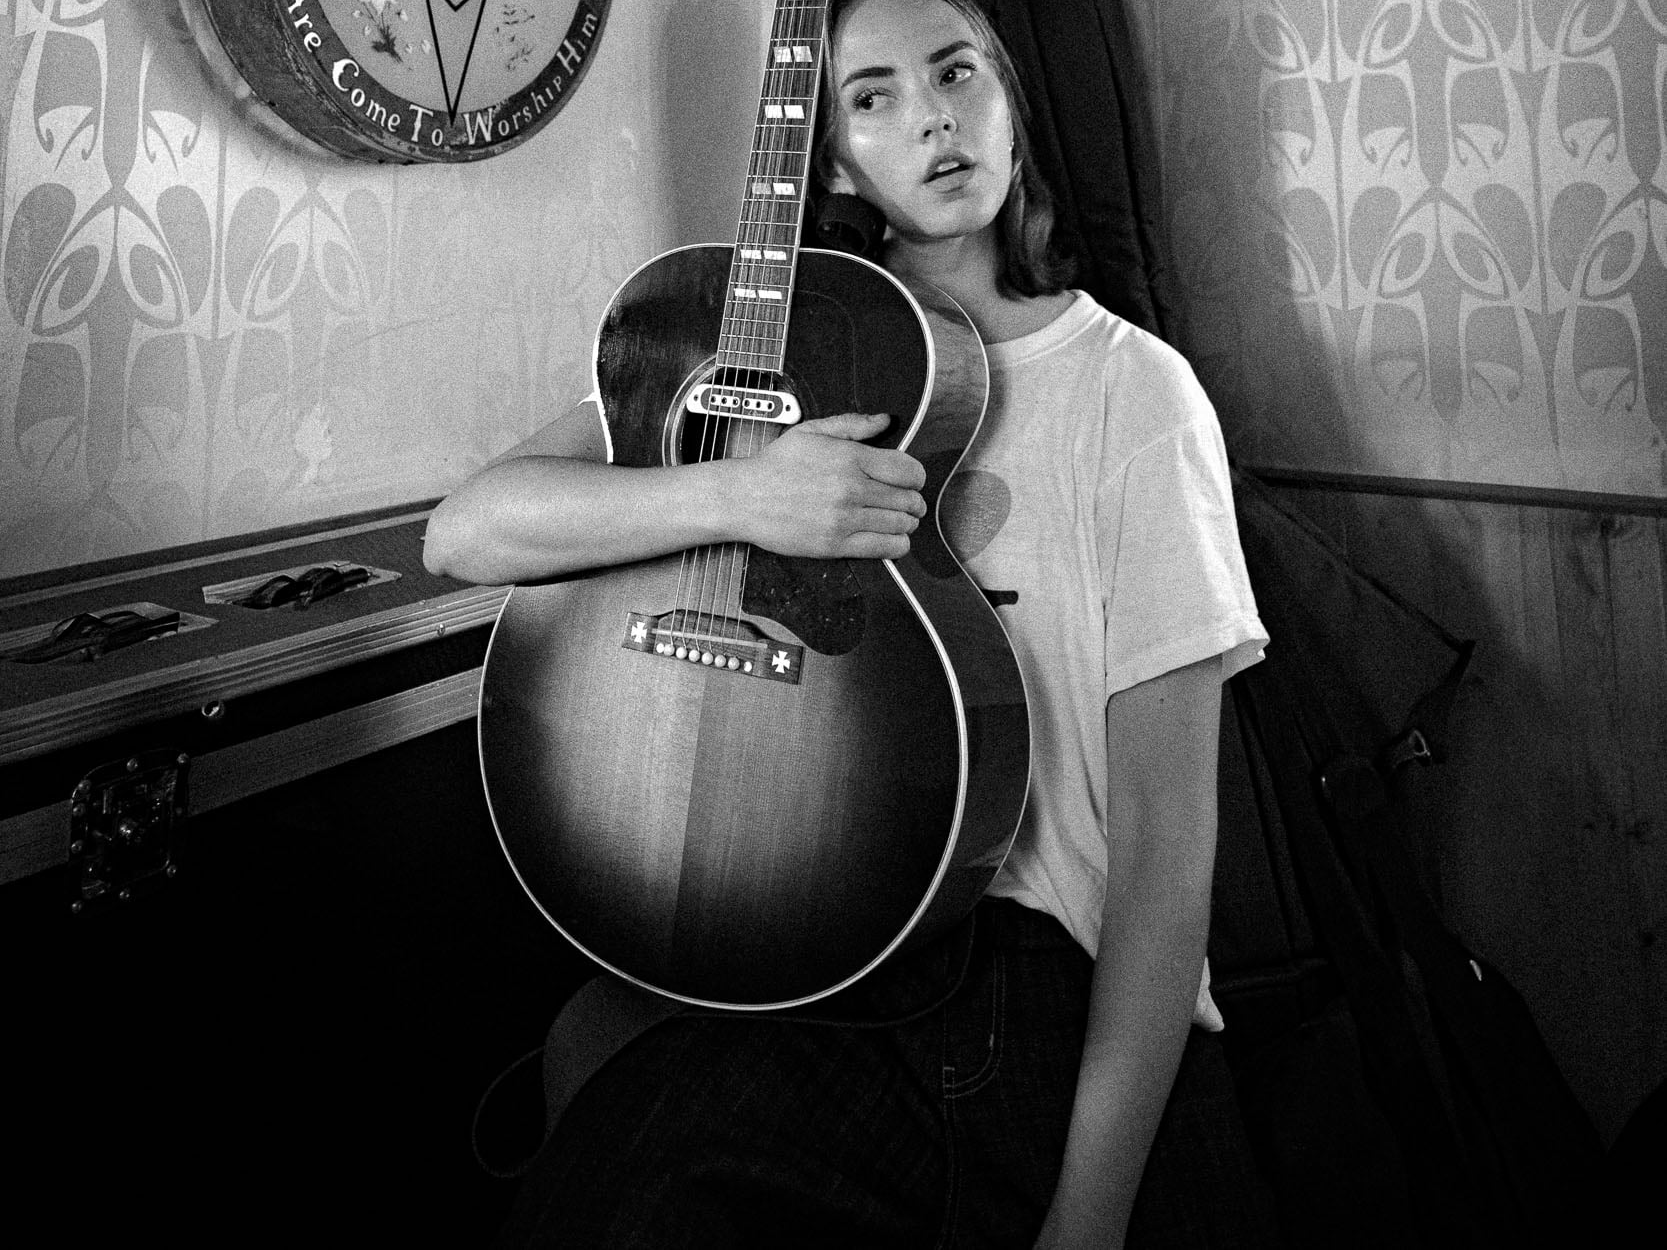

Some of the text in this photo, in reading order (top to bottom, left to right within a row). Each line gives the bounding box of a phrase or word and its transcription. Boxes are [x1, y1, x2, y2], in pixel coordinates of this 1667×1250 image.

[332, 58, 401, 132] Come
[409, 104, 443, 146] To
[463, 76, 562, 145] Worship
[557, 13, 598, 75] Him
